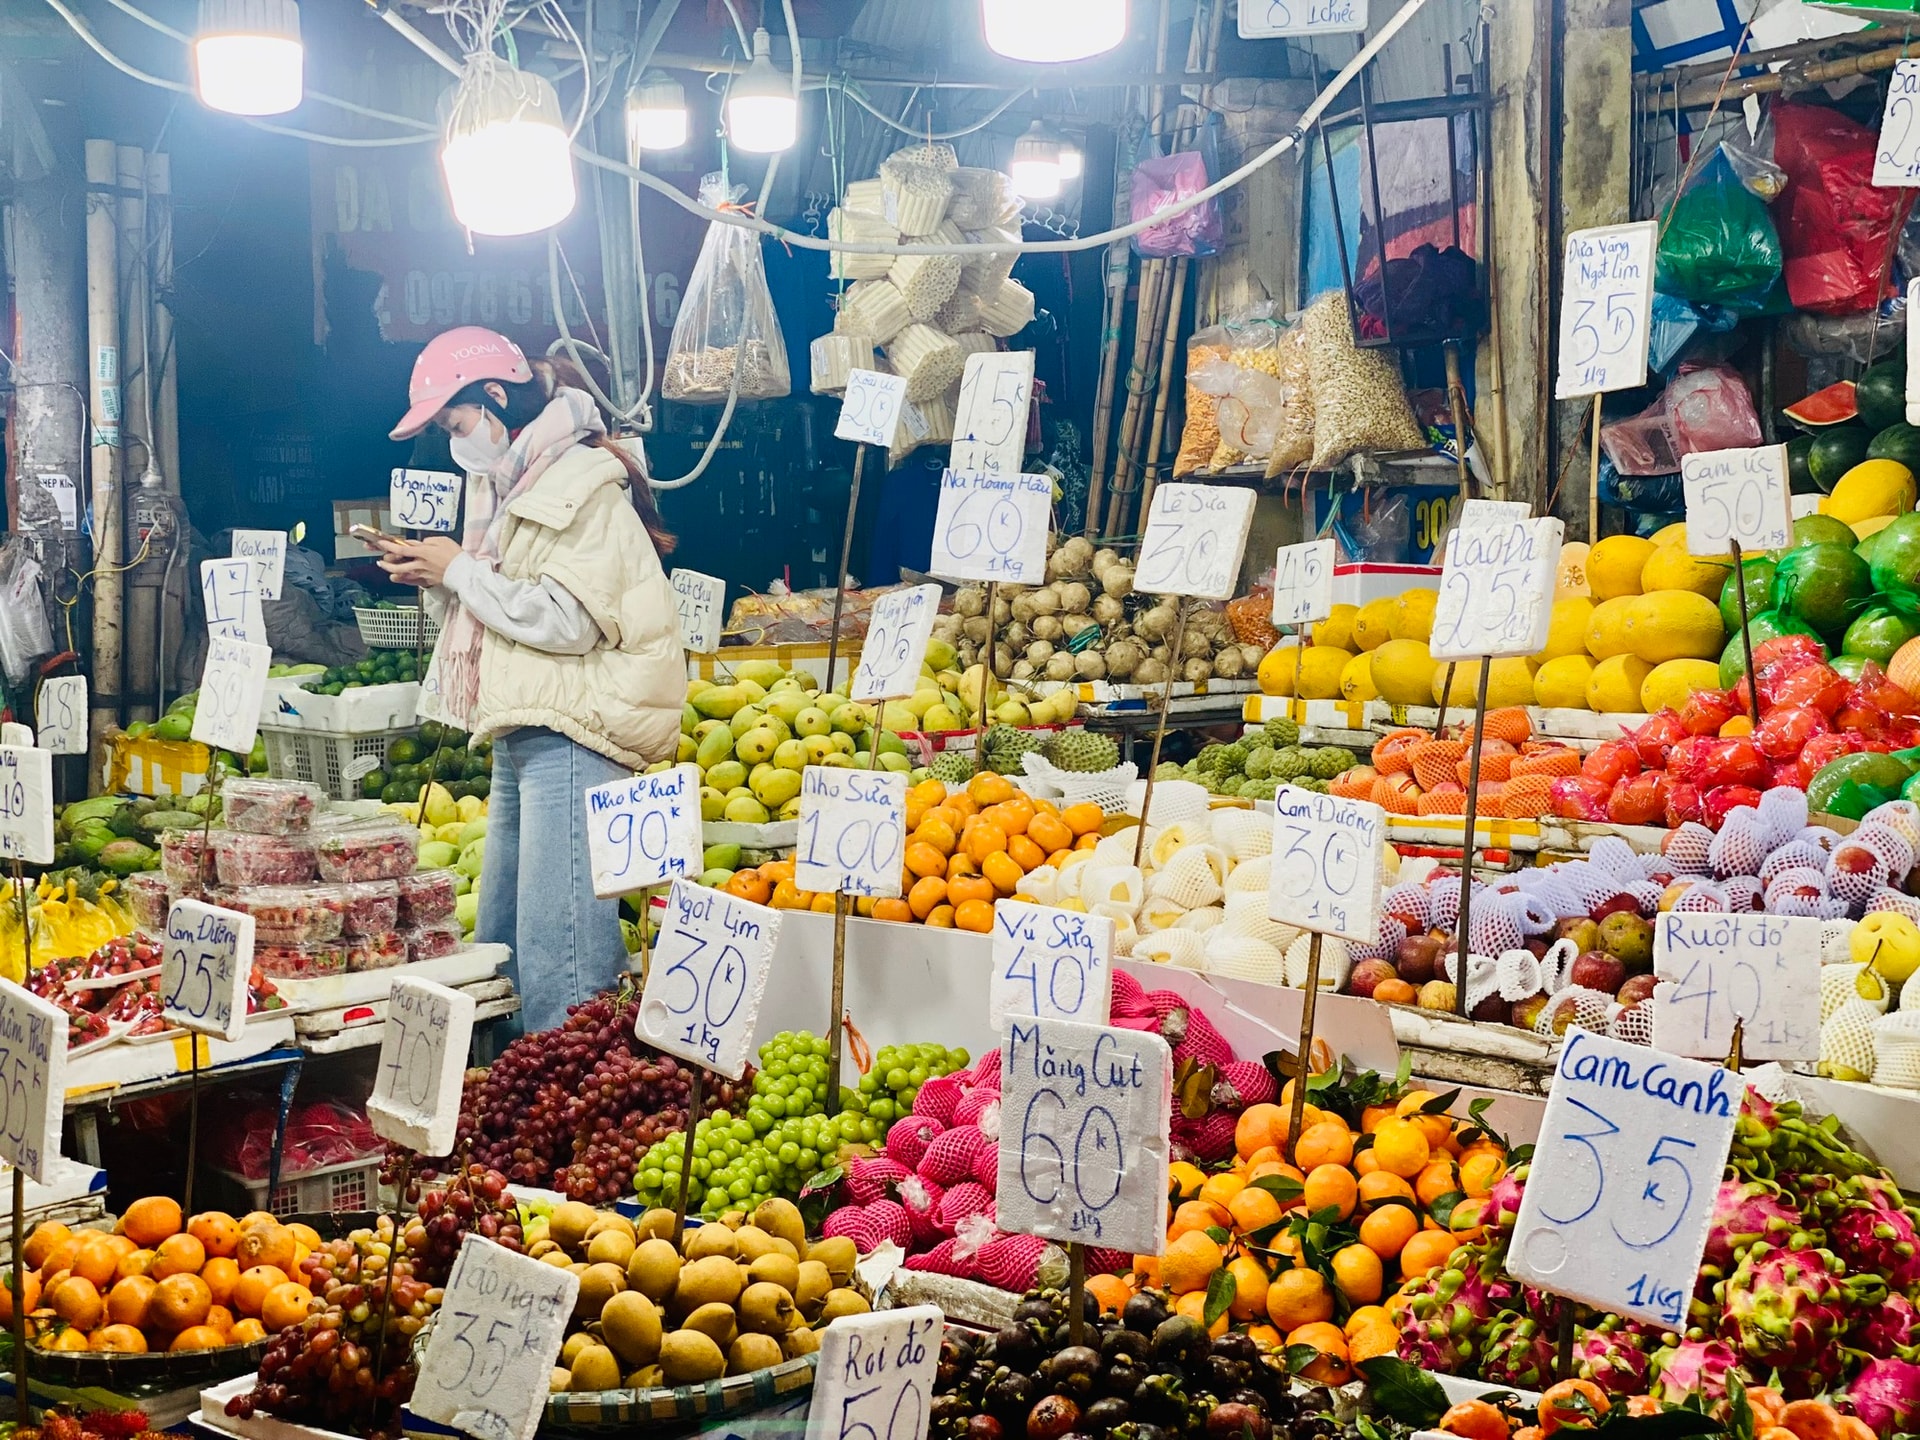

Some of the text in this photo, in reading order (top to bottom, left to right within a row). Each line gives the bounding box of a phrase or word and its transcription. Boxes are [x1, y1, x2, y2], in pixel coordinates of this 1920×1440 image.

[450, 344, 501, 361] YOONA
[1684, 459, 1736, 482] Cam
[591, 790, 625, 814] Nho
[1277, 788, 1312, 819] Cam
[168, 907, 195, 943] Cam
[998, 911, 1038, 940] Vú
[1667, 915, 1742, 954] Ruột
[896, 1317, 934, 1369] đỏ
